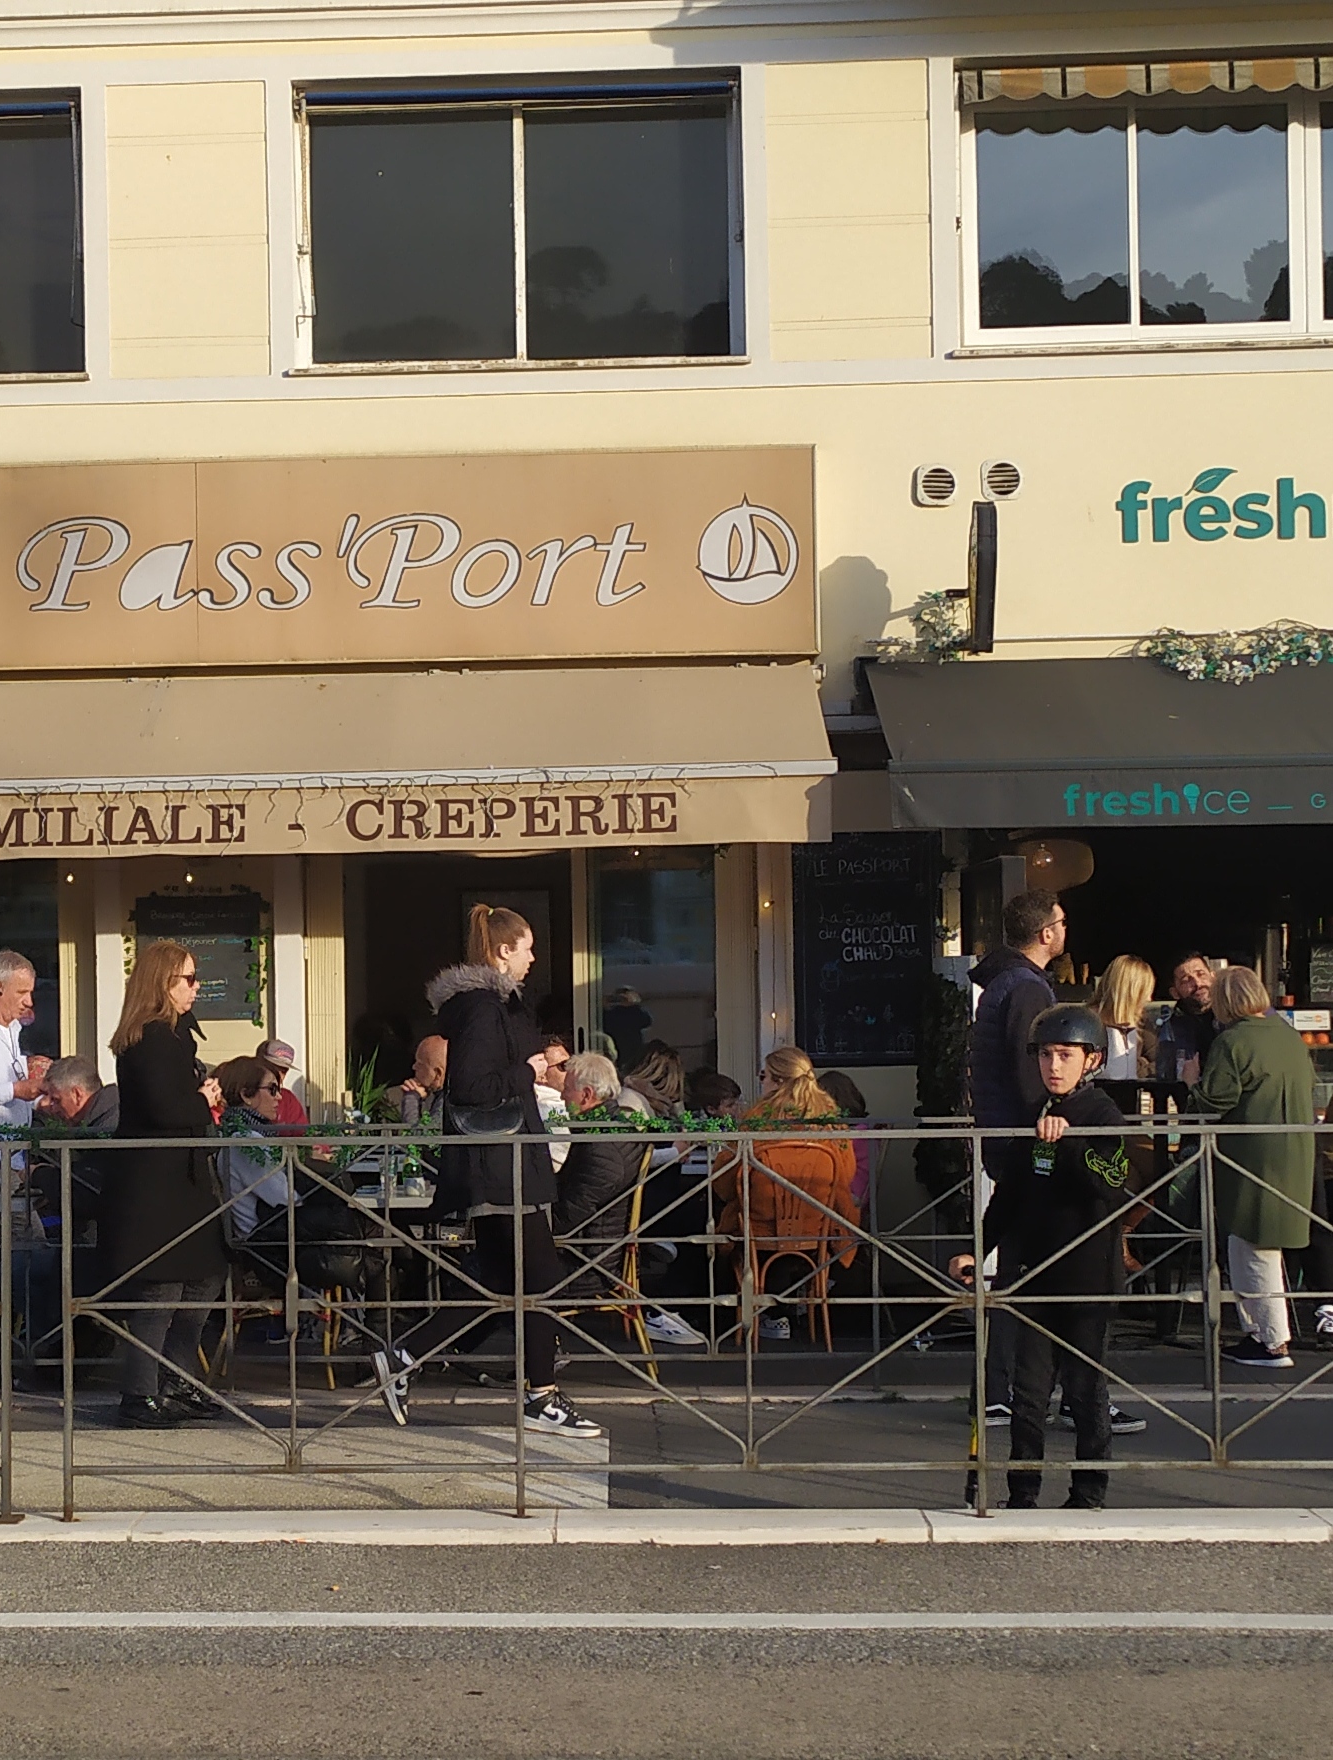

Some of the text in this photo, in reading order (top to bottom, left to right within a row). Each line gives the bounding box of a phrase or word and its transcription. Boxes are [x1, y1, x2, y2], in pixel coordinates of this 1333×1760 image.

[16, 512, 647, 613] Pass'Port
[345, 792, 678, 841] CREPERIE
[813, 859, 827, 877] LE
[841, 924, 917, 945] CHOCOLAT
